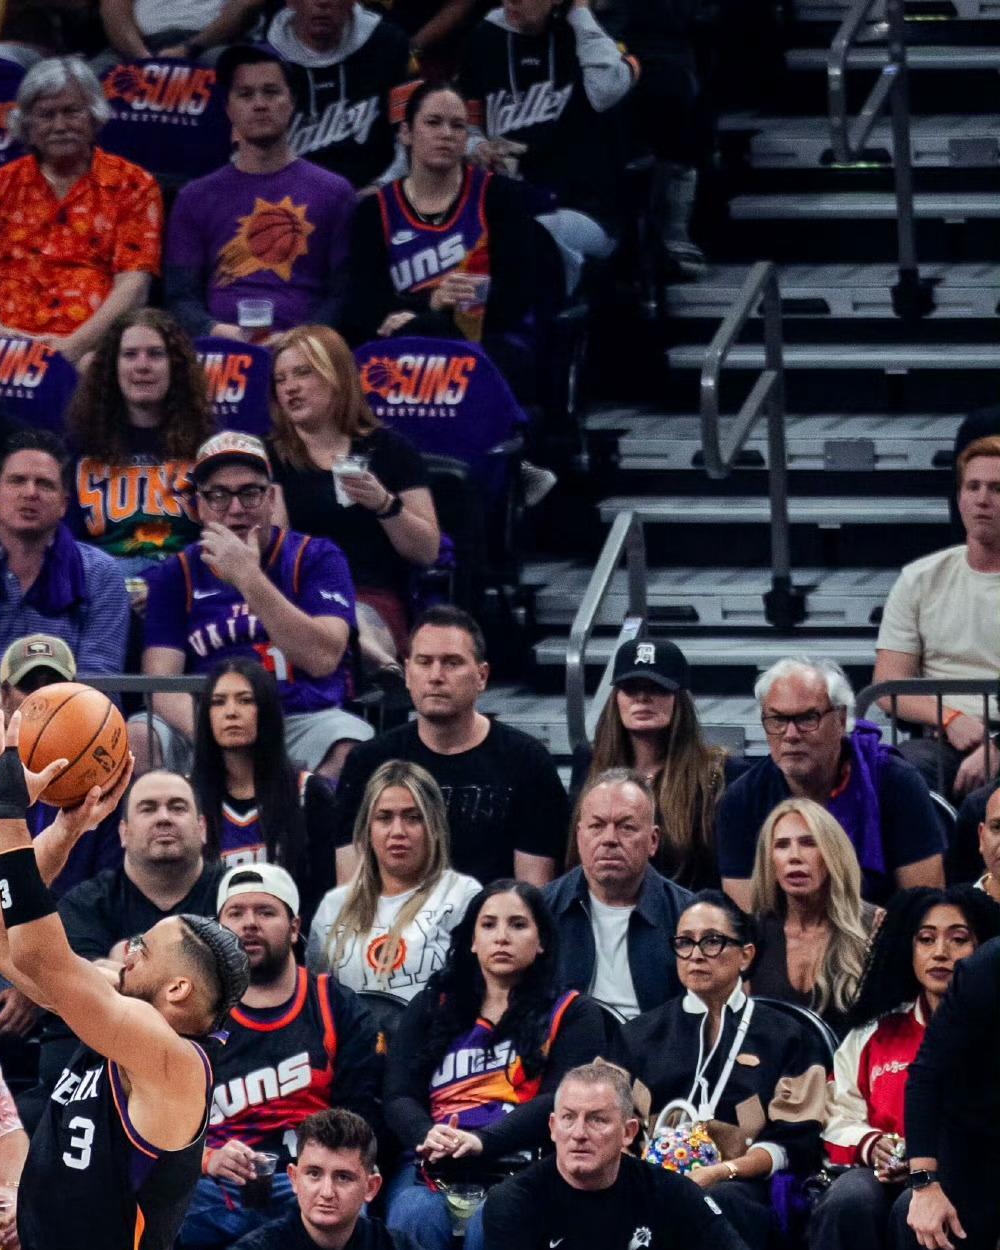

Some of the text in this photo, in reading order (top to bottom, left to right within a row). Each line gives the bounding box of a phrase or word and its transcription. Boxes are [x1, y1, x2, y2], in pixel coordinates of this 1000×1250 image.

[131, 64, 216, 115] SUNS
[390, 233, 467, 292] UNS
[386, 355, 476, 406] SUNS
[62, 1115, 96, 1170] 3
